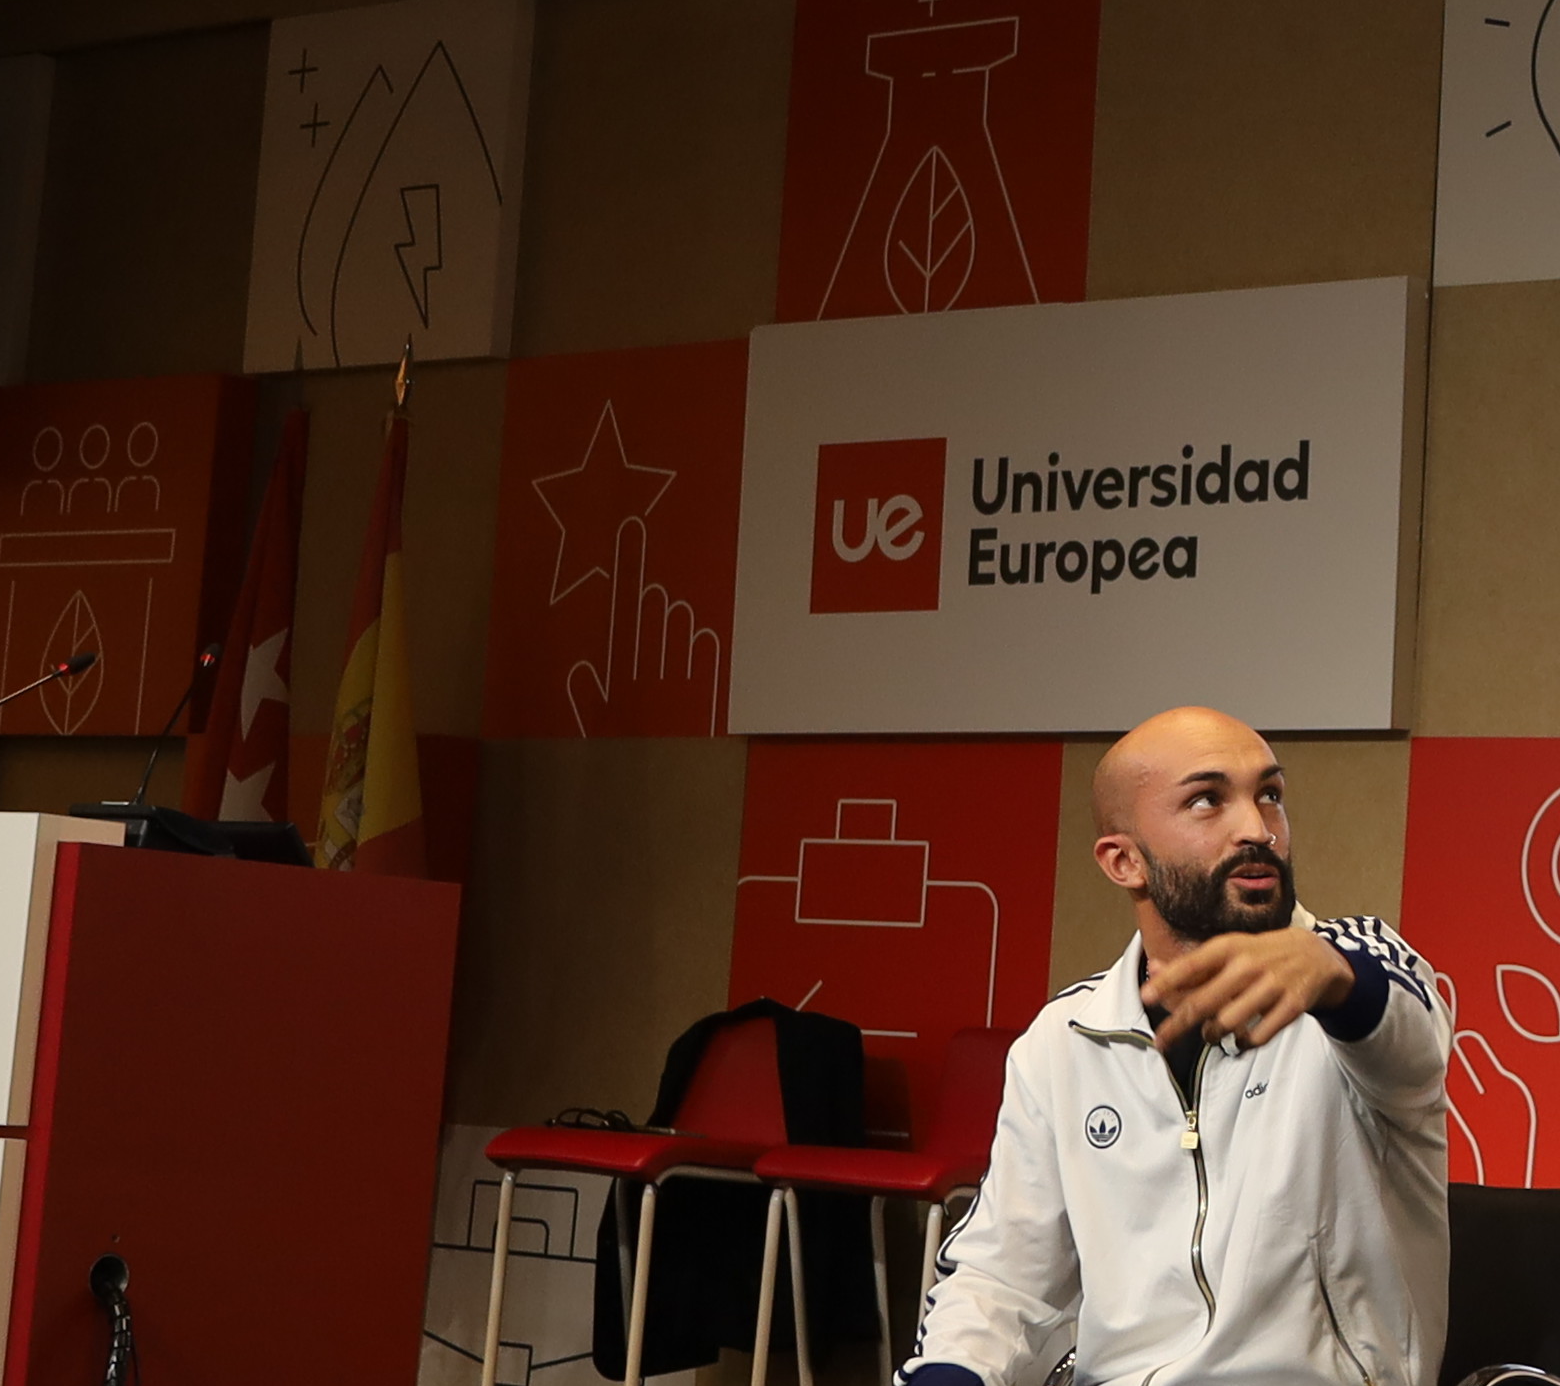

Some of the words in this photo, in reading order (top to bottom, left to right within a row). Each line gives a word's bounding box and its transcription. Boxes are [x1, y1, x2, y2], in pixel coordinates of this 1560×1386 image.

[971, 439, 1310, 515] Universidad
[831, 494, 925, 563] ue
[968, 528, 1198, 595] Europea
